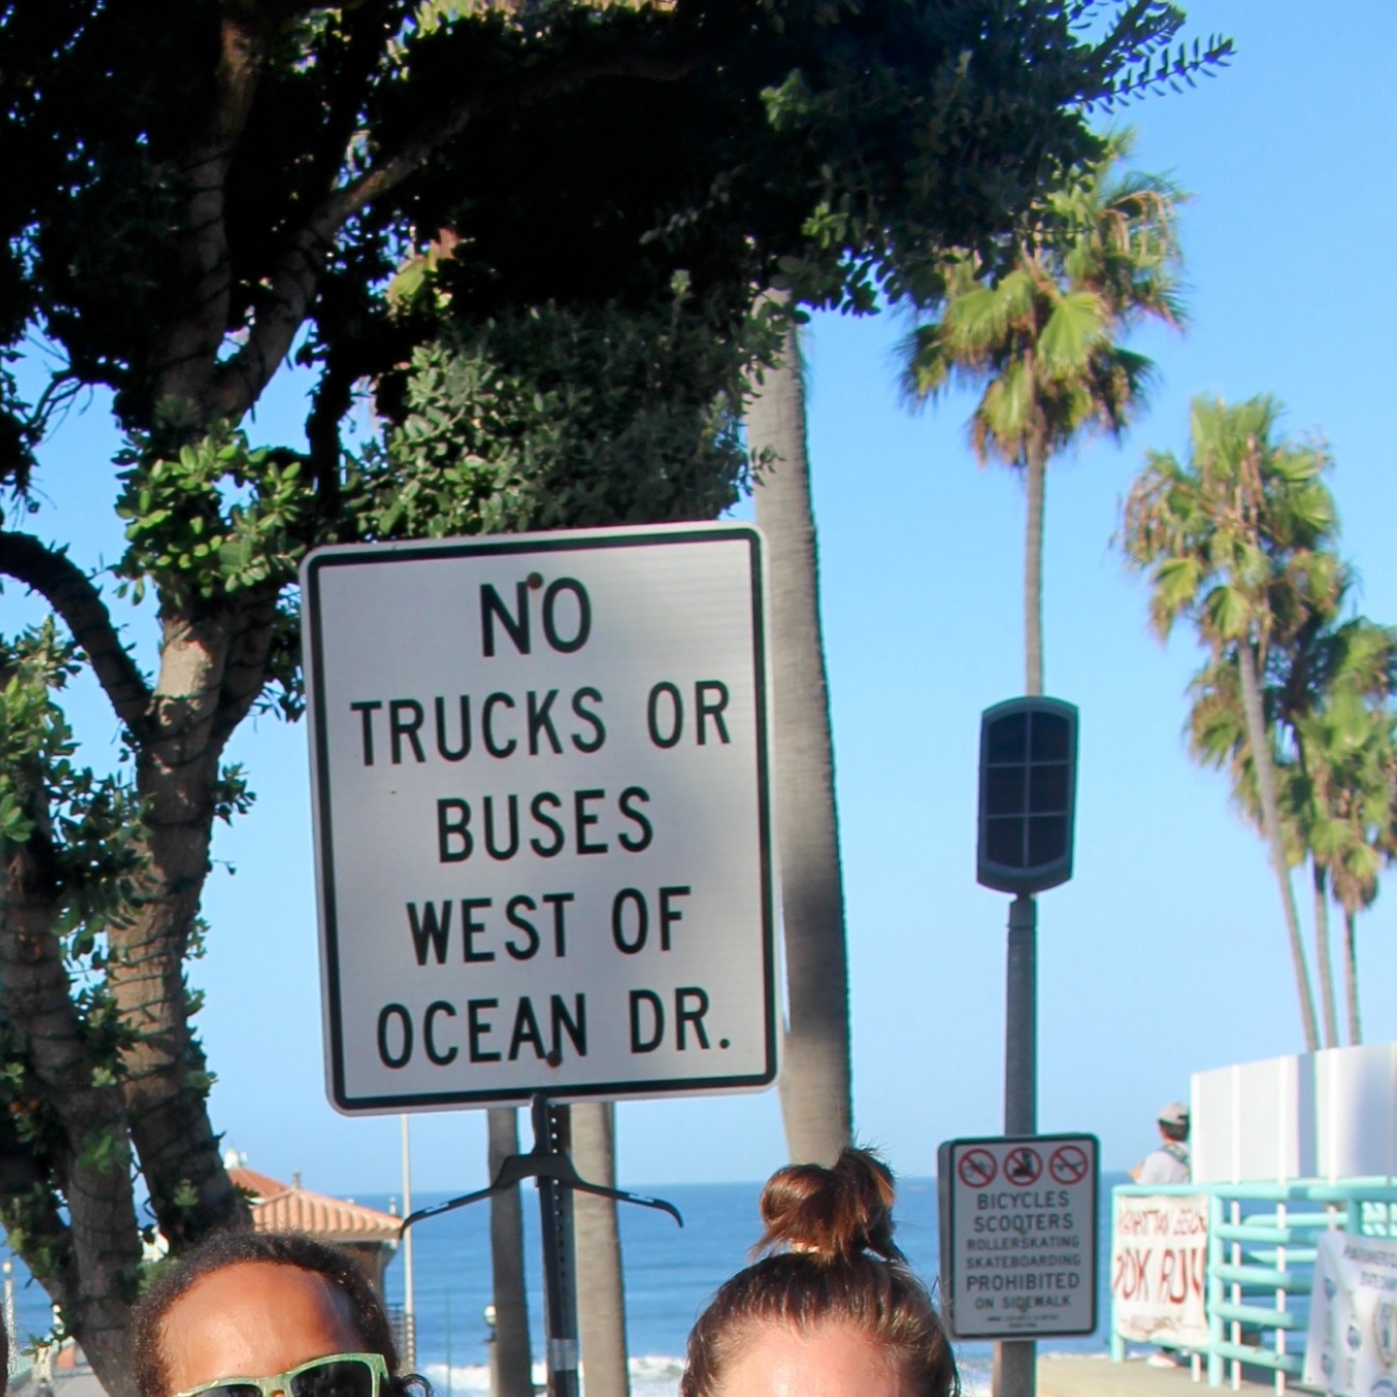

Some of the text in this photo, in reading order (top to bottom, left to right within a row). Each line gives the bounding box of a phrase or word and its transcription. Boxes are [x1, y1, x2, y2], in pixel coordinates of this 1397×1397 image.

[480, 577, 591, 657] NO
[351, 680, 731, 766] TRUCKS OR
[437, 786, 653, 863] BUSES
[407, 886, 691, 966] WEST OF
[377, 987, 730, 1068] OCEAN DR.
[977, 1191, 1069, 1210] BICYCLES
[974, 1213, 1073, 1233] SCOOTERS
[967, 1235, 1080, 1251] ROLLERSKATING
[967, 1254, 1081, 1271] SKATEBOARDING
[967, 1272, 1080, 1291] PROHIBITED
[975, 1295, 1071, 1310] ON SIDEWALK
